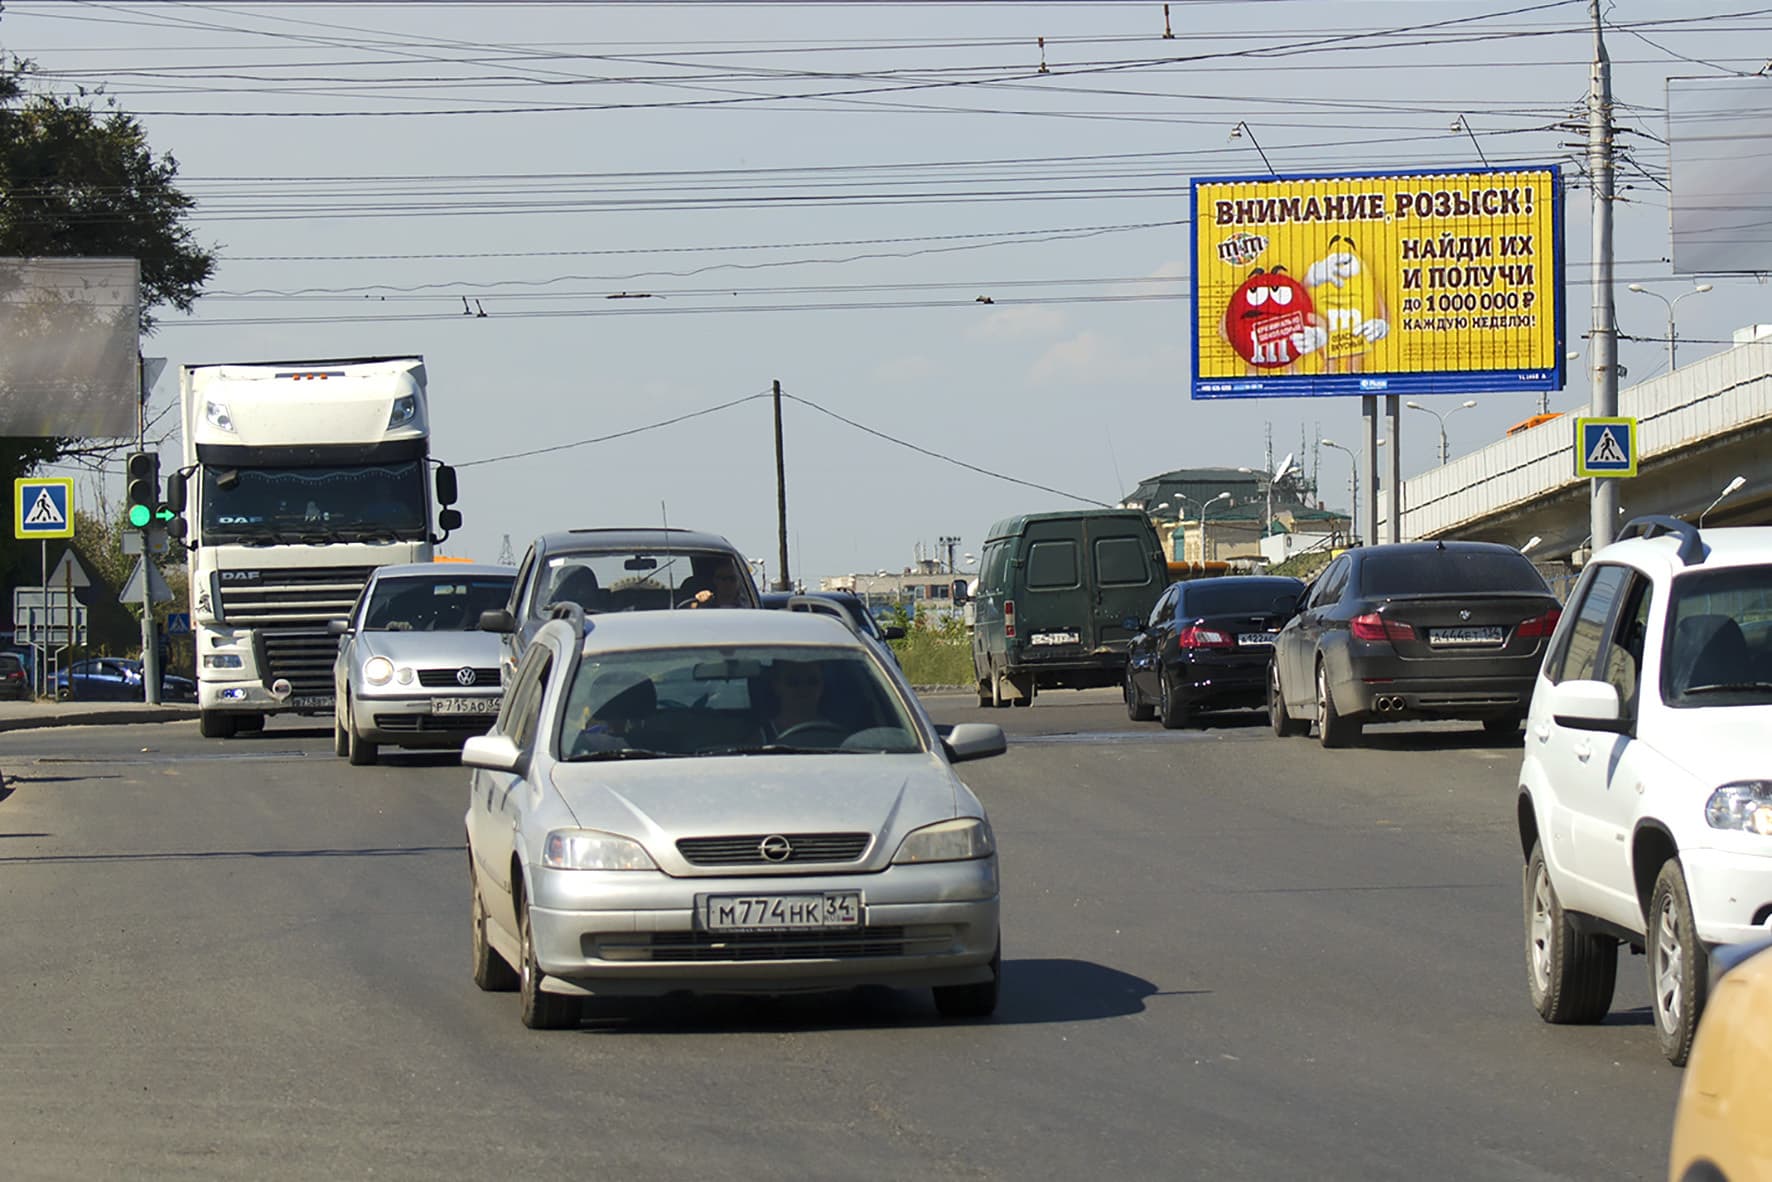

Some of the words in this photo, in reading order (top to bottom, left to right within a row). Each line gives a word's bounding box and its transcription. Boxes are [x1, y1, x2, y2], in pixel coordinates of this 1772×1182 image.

[1215, 195, 1391, 225] ВНИМАНИЕ,
[1395, 188, 1533, 218] РОЗЫСК!
[1402, 233, 1492, 262] НАЙДИ
[1499, 236, 1533, 256] ИХ
[1403, 268, 1421, 289] И
[1428, 265, 1534, 288] ПОЛУЧИ
[1403, 317, 1467, 331] КАЖДУЮ
[1472, 315, 1536, 329] НЕДЕЛЮ!
[219, 516, 263, 524] DAF
[222, 571, 260, 580] DAF
[719, 899, 819, 925] М774НК
[826, 896, 850, 915] 34
